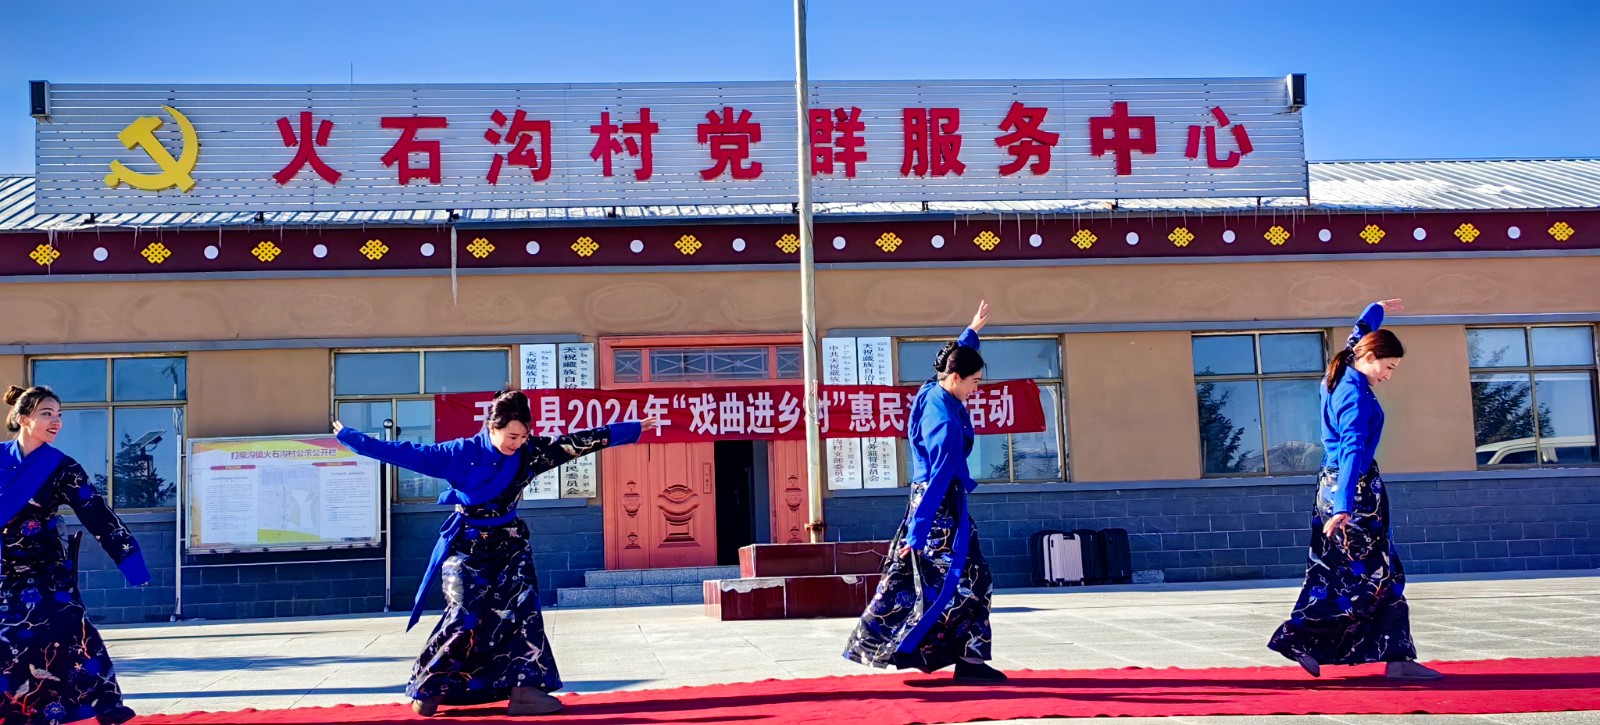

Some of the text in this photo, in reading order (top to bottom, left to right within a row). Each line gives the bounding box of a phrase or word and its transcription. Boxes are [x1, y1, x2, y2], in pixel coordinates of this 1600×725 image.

[272, 101, 1254, 186] 火石沟村党群服务中心
[829, 345, 841, 385] 中共天祝藏族
